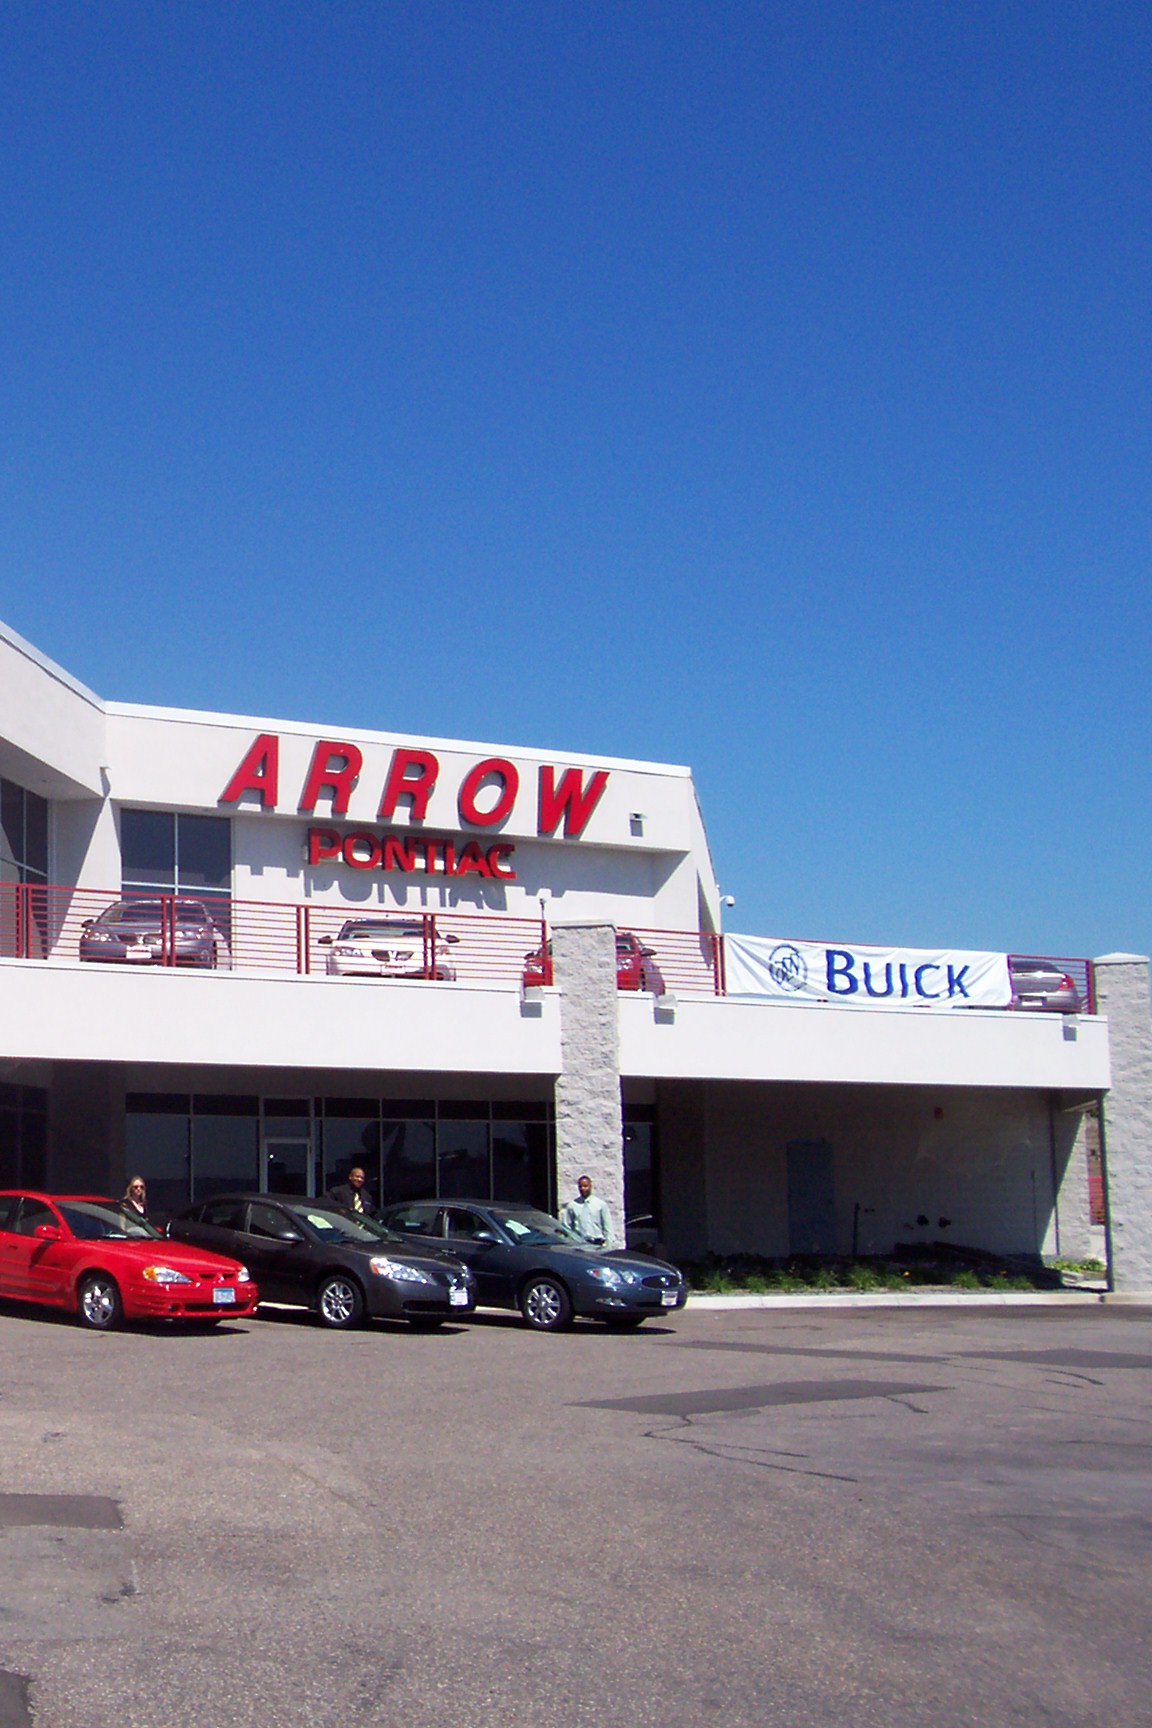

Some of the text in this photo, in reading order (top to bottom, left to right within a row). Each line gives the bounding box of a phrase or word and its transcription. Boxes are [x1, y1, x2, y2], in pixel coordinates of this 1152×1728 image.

[218, 734, 610, 836] ARROW
[307, 827, 516, 880] PONTIAC
[825, 949, 970, 998] BUICK
